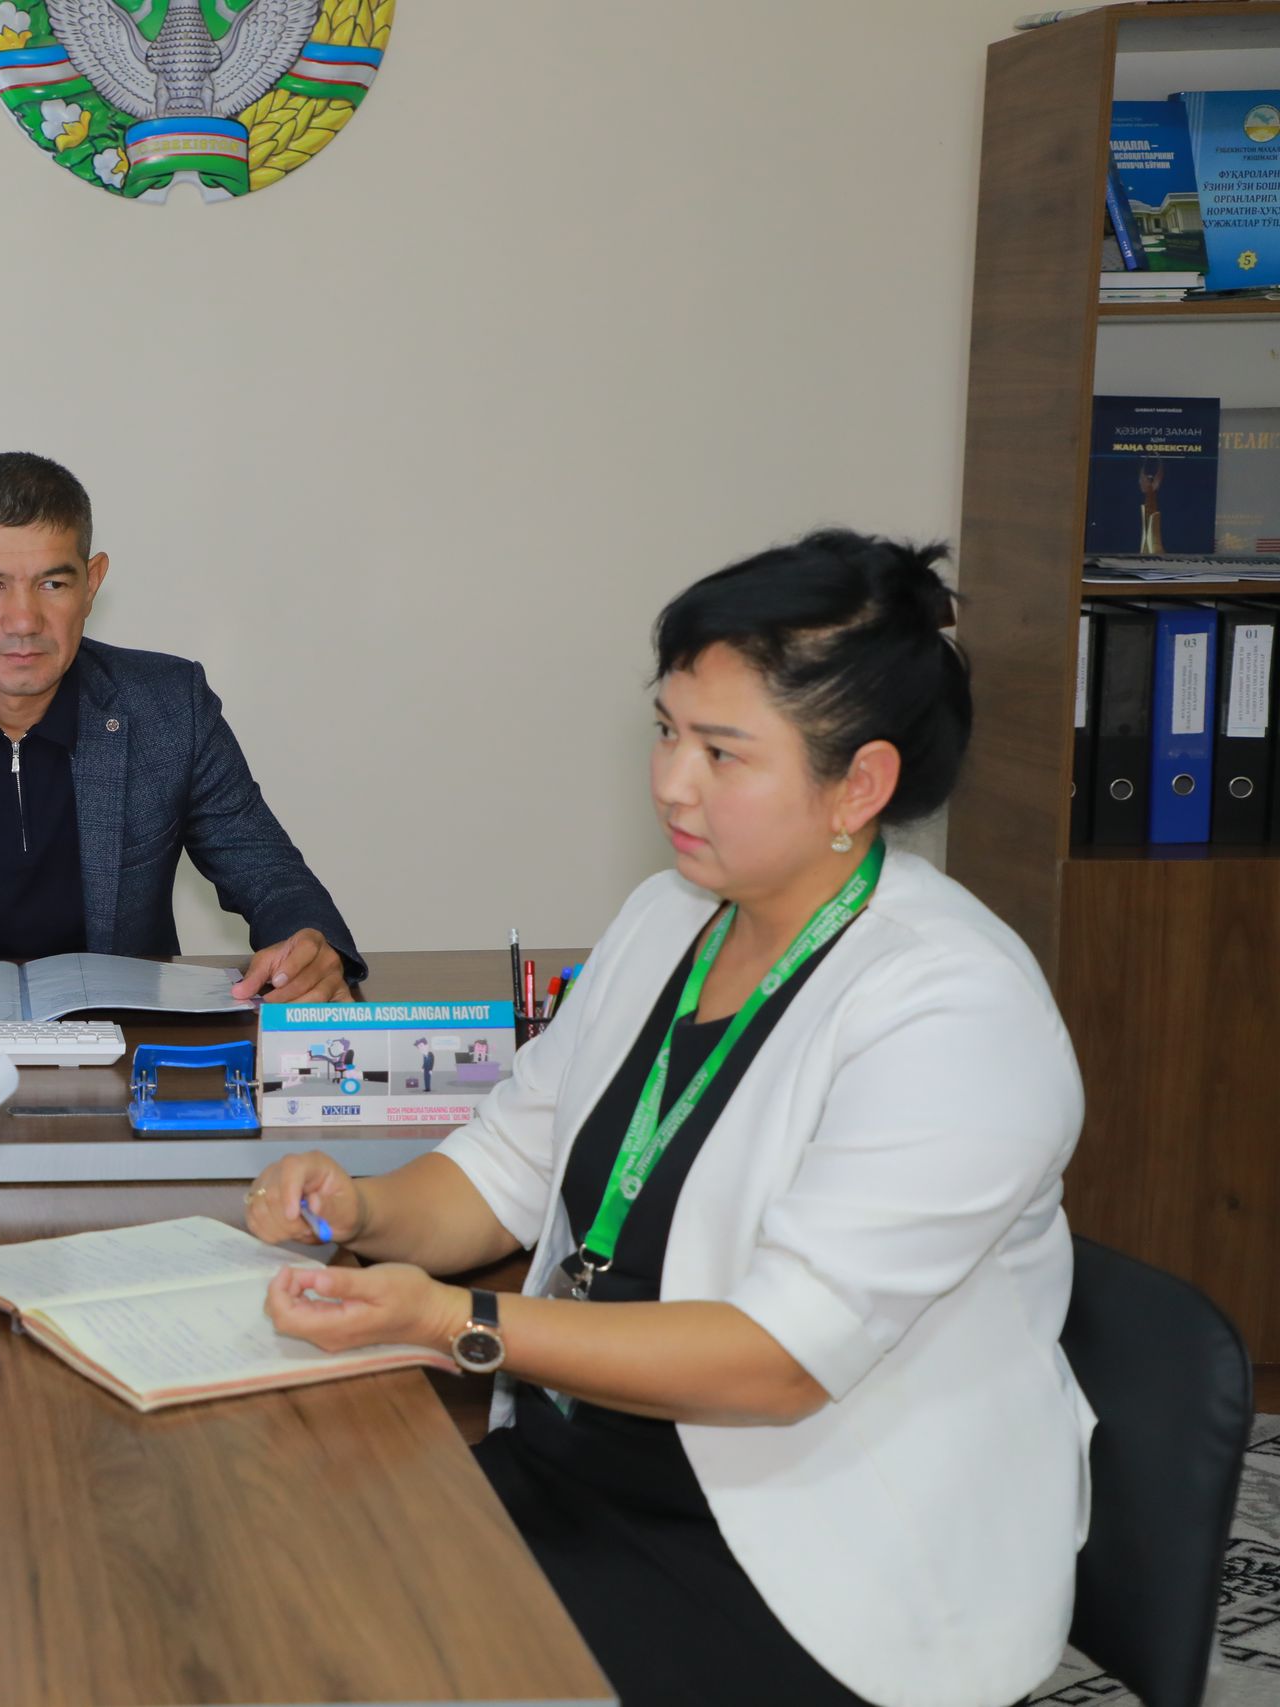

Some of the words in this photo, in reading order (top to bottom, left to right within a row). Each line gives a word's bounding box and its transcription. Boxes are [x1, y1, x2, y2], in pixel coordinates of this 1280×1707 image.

[1243, 255, 1252, 265] 5
[1245, 629, 1258, 639] 01
[1184, 638, 1197, 648] 03
[286, 1008, 371, 1022] KORRUPSIYAGA
[375, 1006, 450, 1020] ASOSLANGAN
[452, 1005, 490, 1020] HAYOT
[322, 1106, 360, 1115] YXHT
